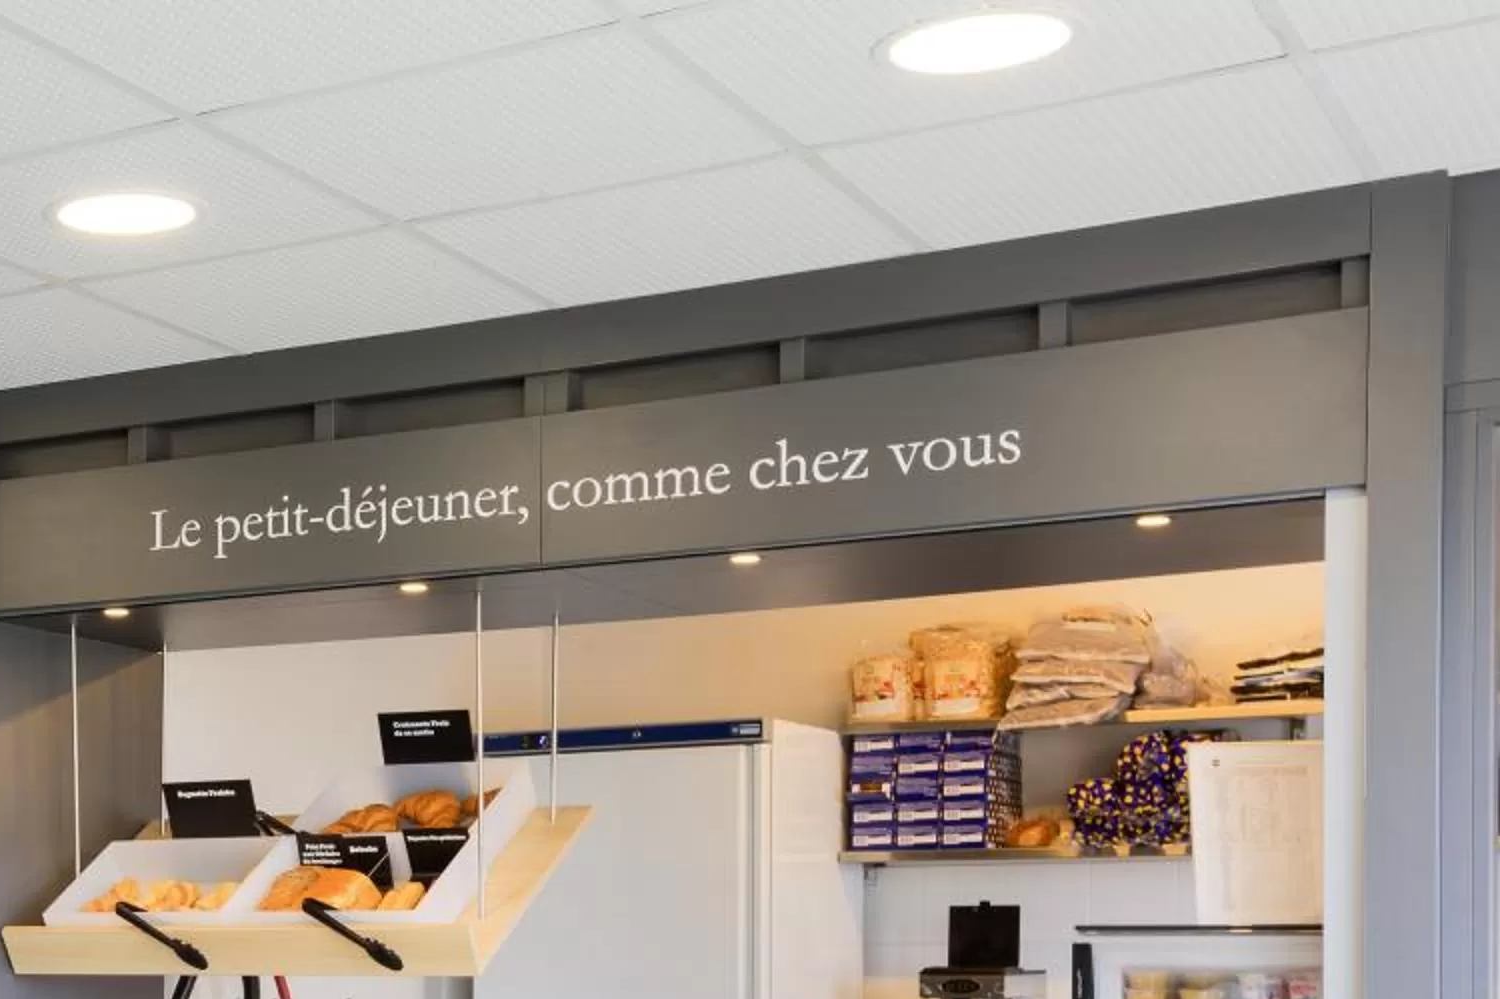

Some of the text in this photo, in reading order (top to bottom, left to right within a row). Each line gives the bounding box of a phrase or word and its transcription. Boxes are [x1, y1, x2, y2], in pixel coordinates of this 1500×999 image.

[149, 428, 1022, 560] Le petit-déjeuner, comme chez vous
